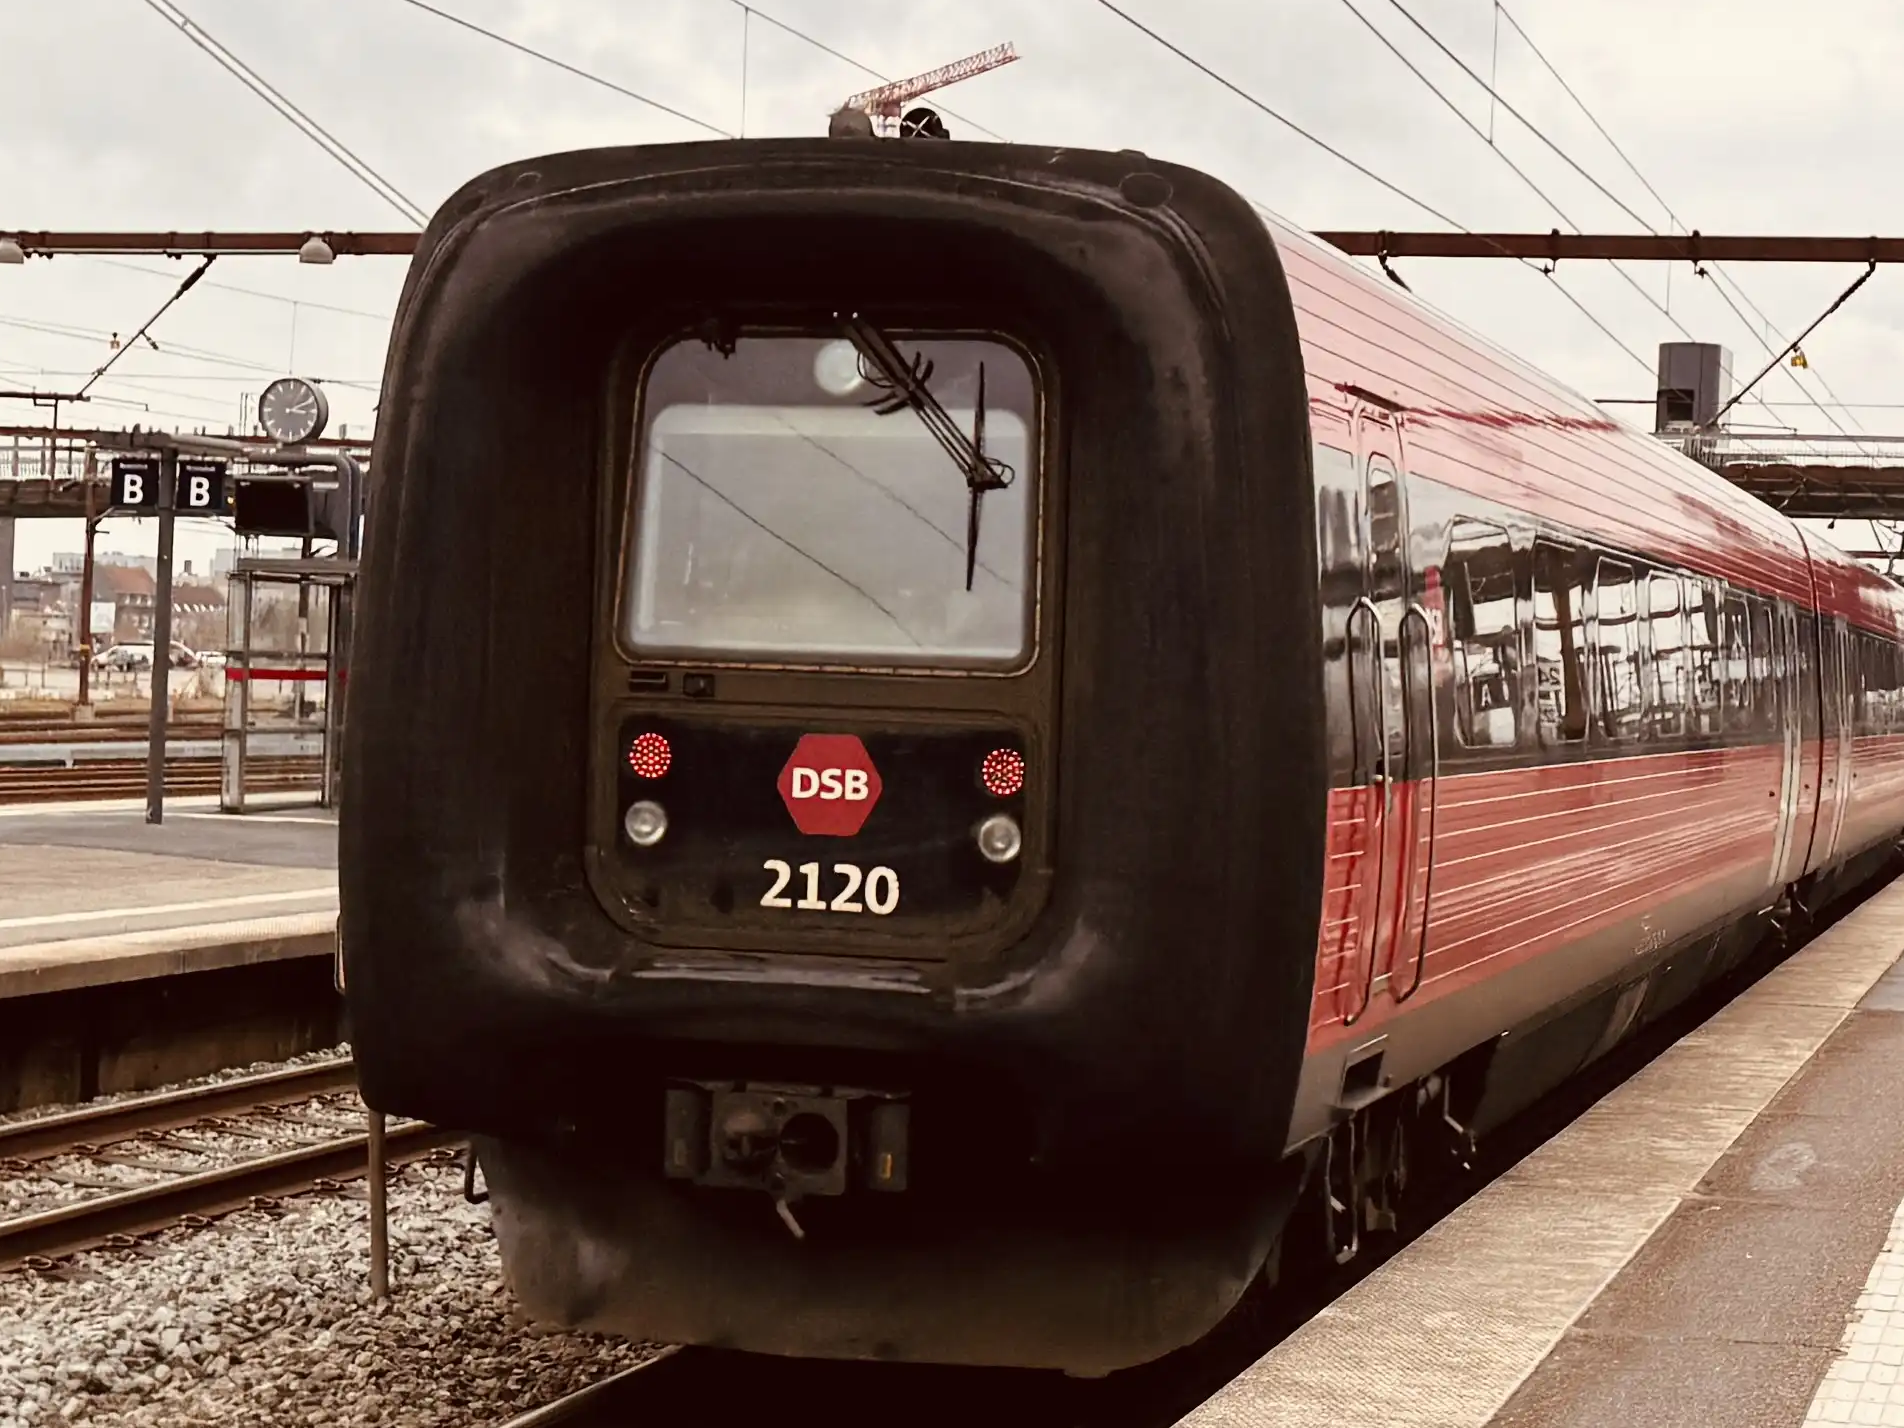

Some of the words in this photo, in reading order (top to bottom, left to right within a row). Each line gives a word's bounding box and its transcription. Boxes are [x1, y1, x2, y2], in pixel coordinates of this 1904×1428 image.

[123, 474, 144, 504] B
[189, 476, 210, 507] B
[792, 767, 869, 801] DSB
[760, 859, 900, 915] 2120
